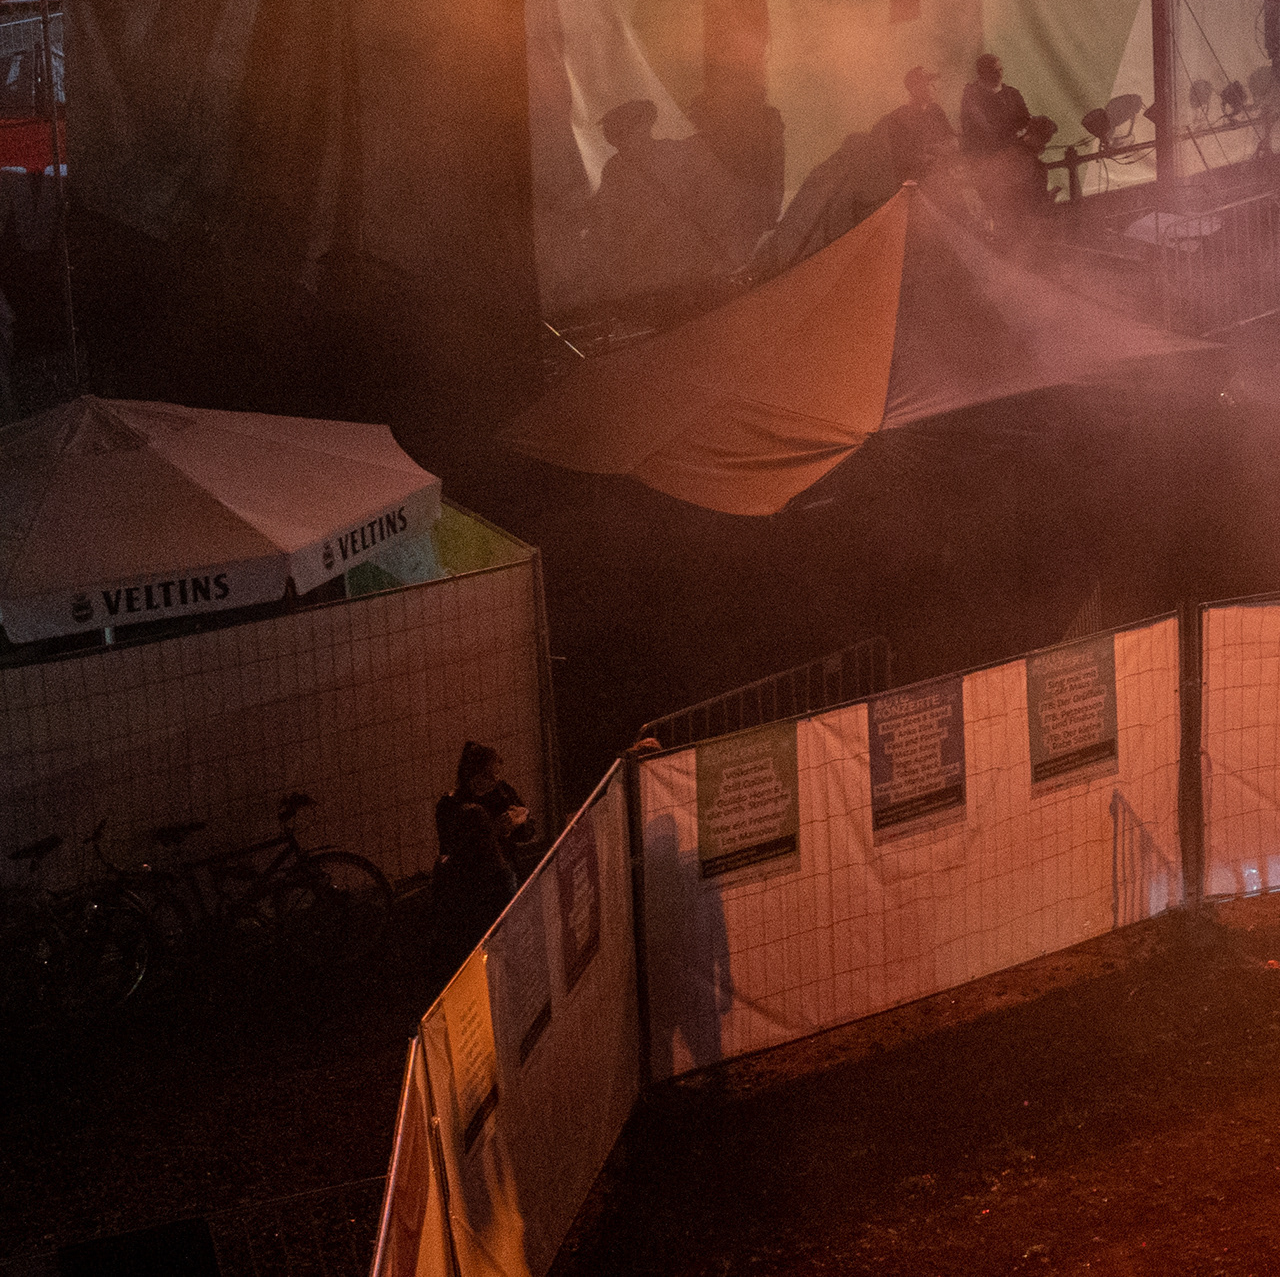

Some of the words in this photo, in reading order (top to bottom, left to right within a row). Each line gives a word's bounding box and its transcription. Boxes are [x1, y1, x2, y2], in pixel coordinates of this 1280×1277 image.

[337, 507, 409, 563] VELTINS
[102, 573, 231, 618] VELTINS
[874, 696, 940, 720] KONZERTE
